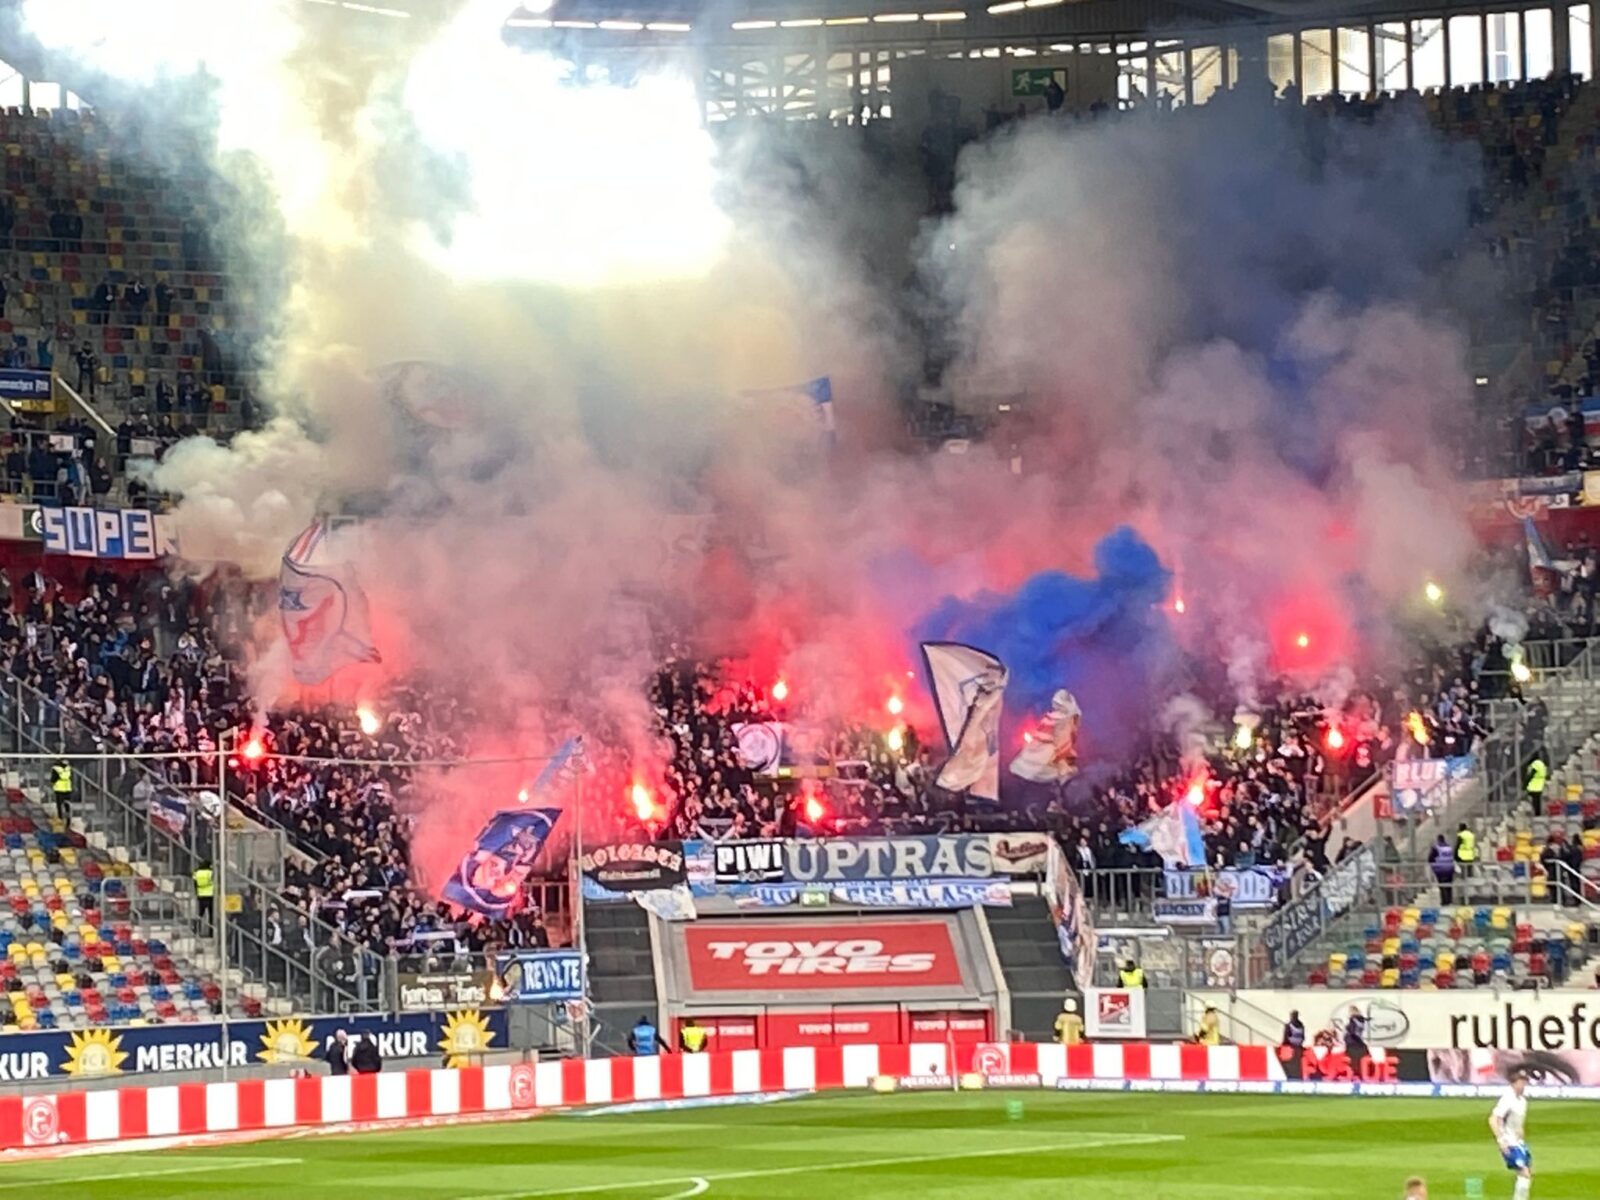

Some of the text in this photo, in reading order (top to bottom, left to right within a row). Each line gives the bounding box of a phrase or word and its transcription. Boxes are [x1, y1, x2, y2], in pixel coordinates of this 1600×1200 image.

[717, 843, 782, 872] PIWI
[786, 837, 992, 881] UPTRAS
[707, 939, 883, 959] TOYO
[743, 954, 936, 975] TIRES
[136, 1041, 248, 1072] MERKUR
[325, 1031, 428, 1060] EKUR
